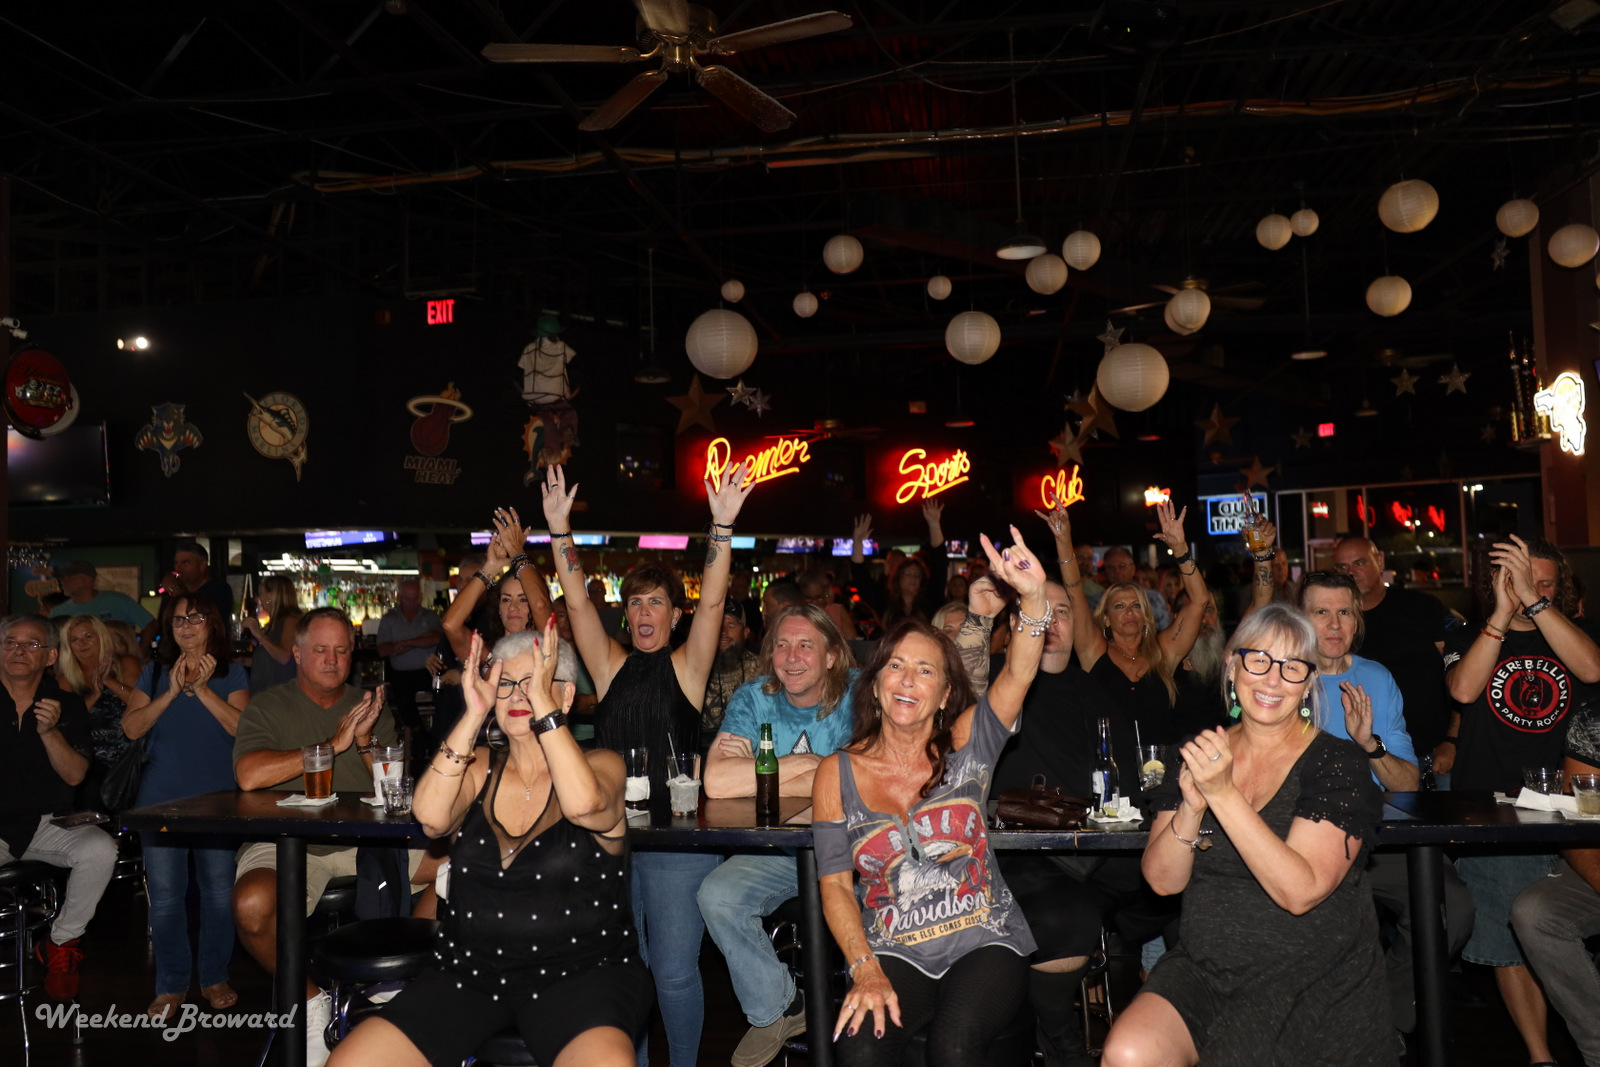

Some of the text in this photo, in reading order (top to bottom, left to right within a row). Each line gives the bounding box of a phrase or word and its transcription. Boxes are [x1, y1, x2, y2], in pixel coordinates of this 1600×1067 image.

[427, 299, 455, 325] EXIT
[403, 455, 458, 471] MIAMI
[415, 468, 461, 485] HEAT
[896, 448, 970, 504] Sports
[1041, 465, 1085, 509] Club
[1501, 707, 1560, 728] PARTY ROCK
[872, 884, 1000, 941] Davidson
[919, 927, 936, 939] ELSE
[938, 919, 961, 933] COMES
